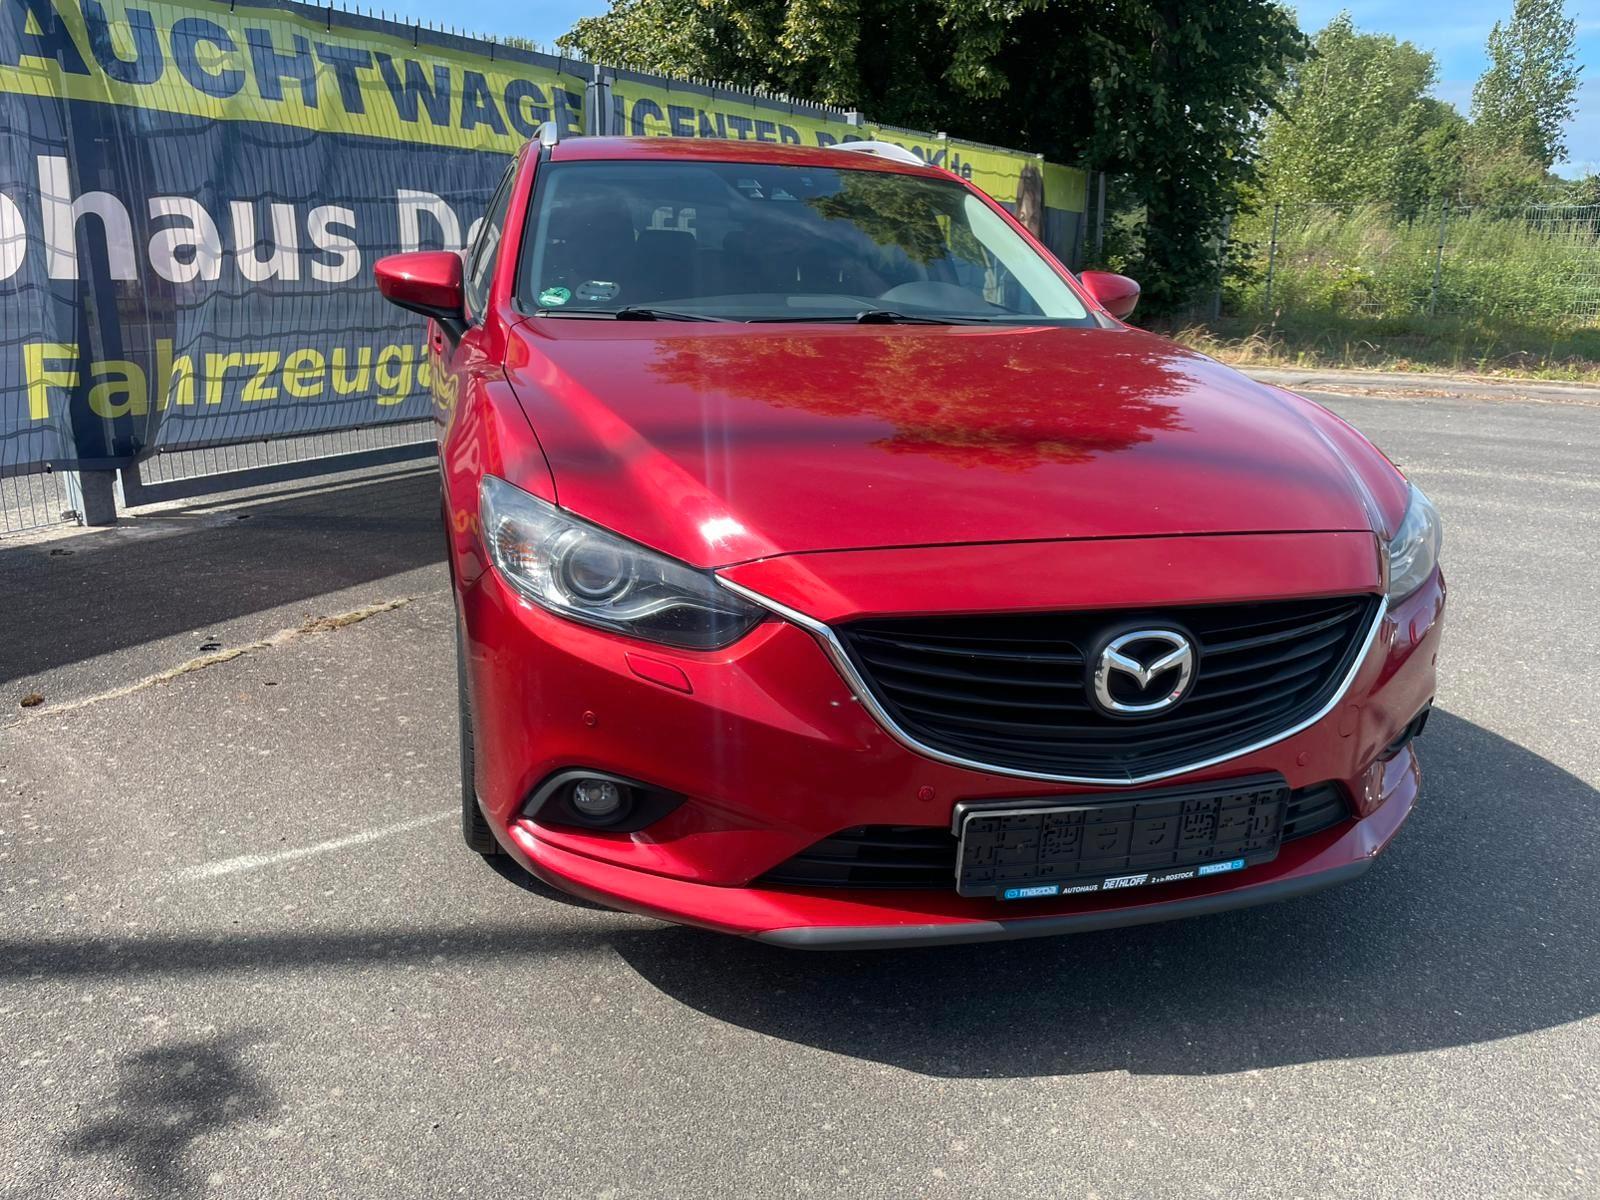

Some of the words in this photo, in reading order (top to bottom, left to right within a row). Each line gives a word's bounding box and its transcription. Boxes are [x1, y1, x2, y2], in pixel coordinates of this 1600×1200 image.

[1019, 885, 1058, 898] mazda
[1062, 884, 1099, 895] AUTOHAUS
[1102, 874, 1149, 890] DETHLOFF
[1165, 871, 1194, 881] ROSTOCK
